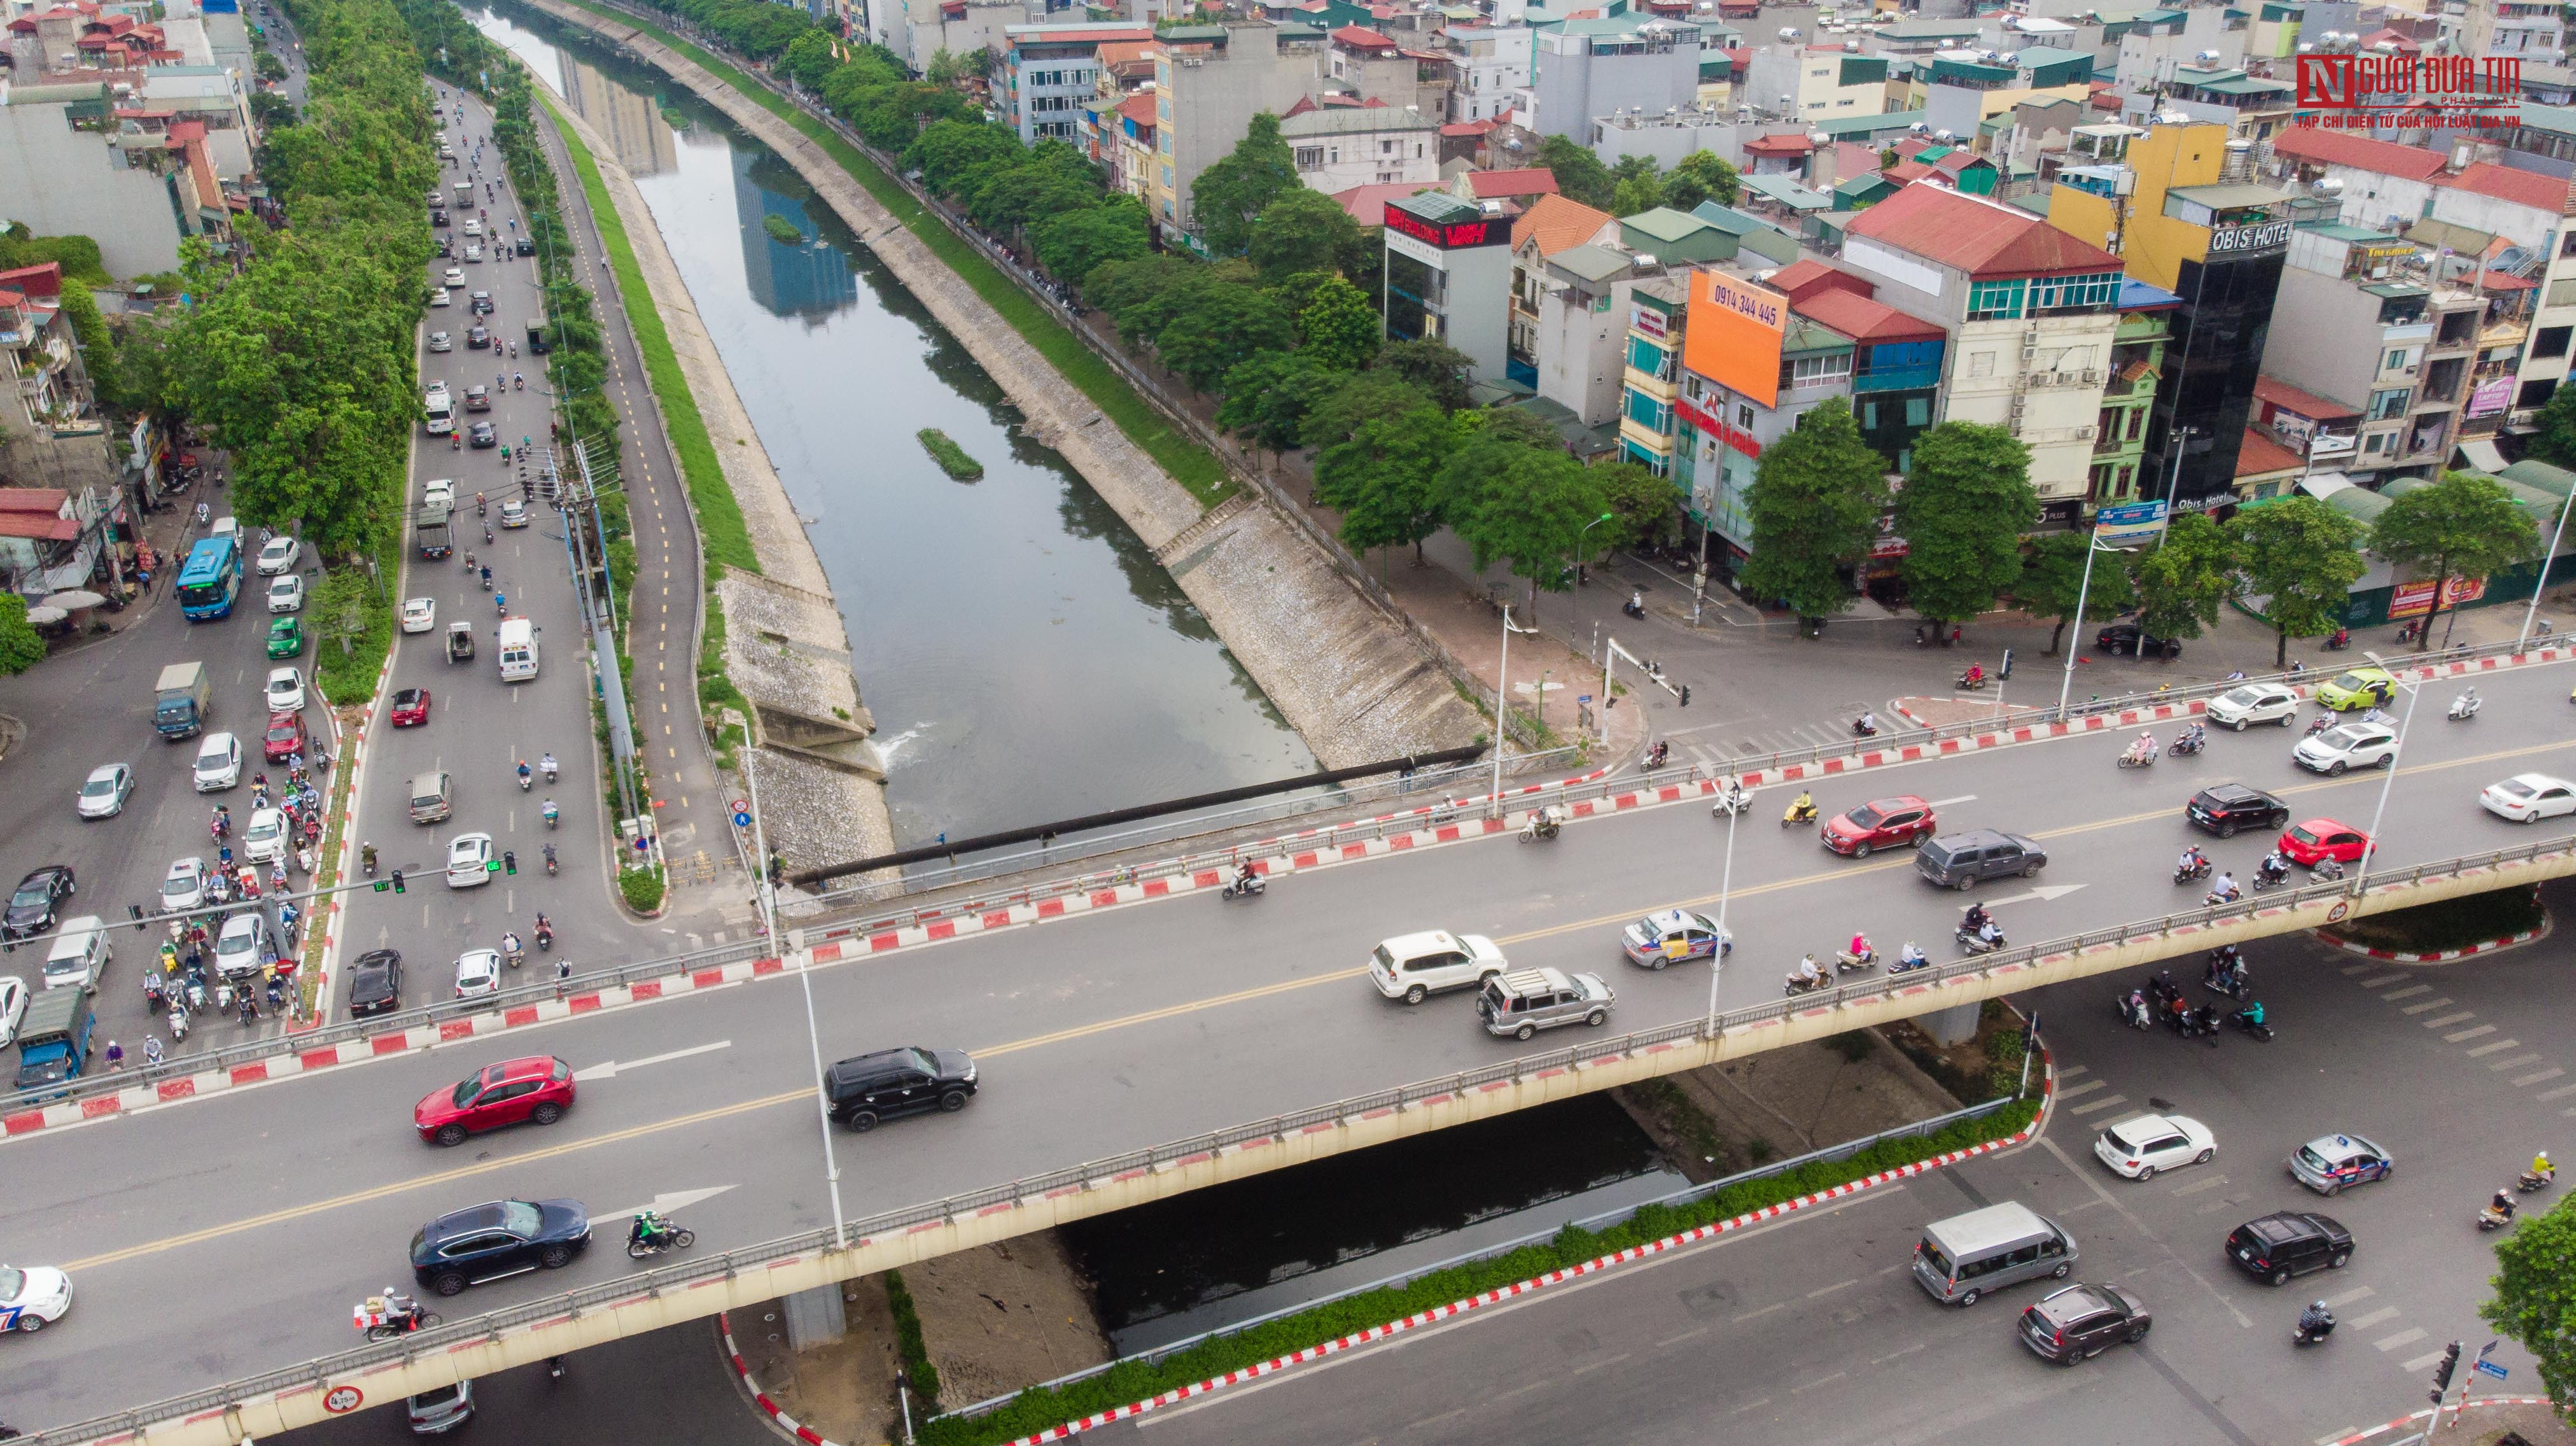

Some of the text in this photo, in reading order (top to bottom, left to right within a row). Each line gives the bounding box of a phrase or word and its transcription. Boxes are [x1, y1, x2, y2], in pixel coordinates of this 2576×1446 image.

[1404, 218, 1440, 245] BUILDING
[2213, 223, 2293, 250] OBIS HOTEL
[1715, 284, 1737, 309] 0914
[1739, 295, 1756, 318] 344
[1758, 303, 1777, 326] 445
[2178, 491, 2227, 510] Obis Hotel
[2050, 512, 2067, 520] PLUS
